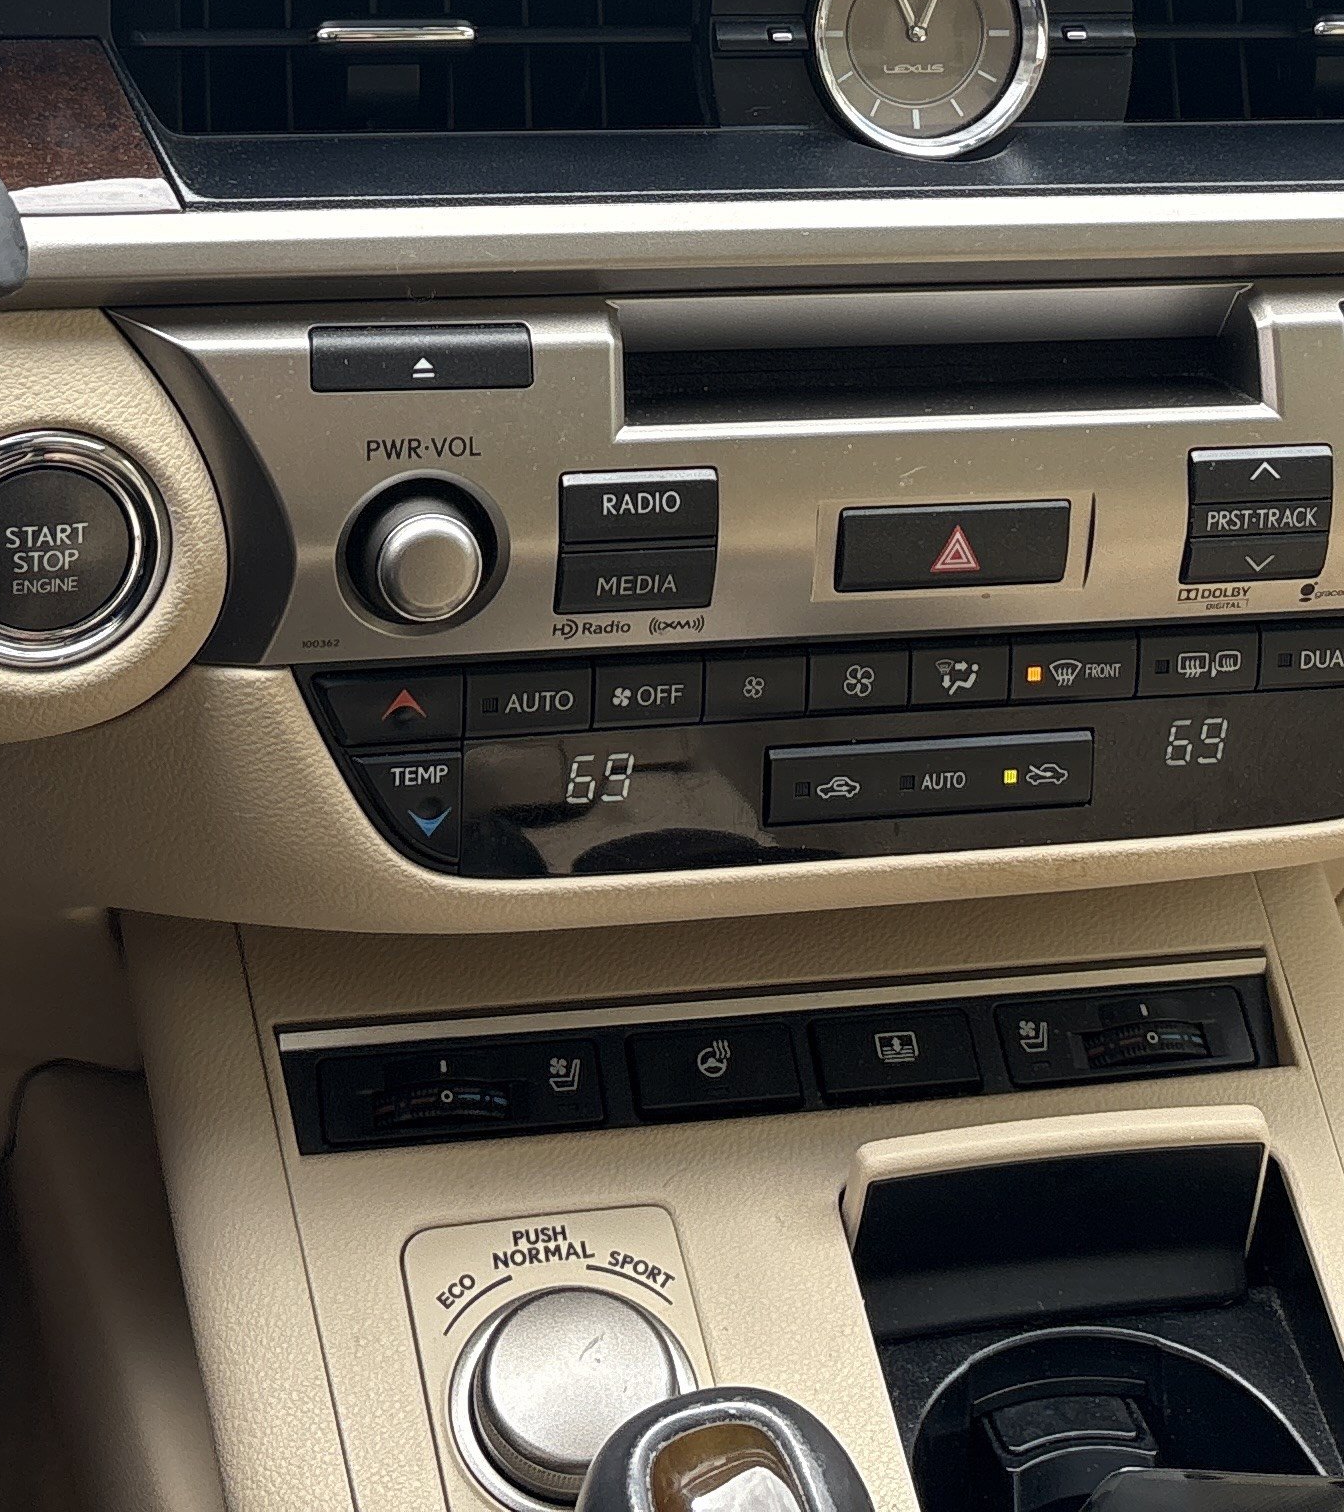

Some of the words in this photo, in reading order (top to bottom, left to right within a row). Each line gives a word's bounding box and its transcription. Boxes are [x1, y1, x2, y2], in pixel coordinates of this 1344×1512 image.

[884, 63, 945, 74] LEXUS
[602, 490, 681, 516] RADIO
[5, 522, 89, 549] START
[13, 549, 79, 573] STOP
[12, 576, 79, 595] ENGINE
[596, 574, 677, 597] MEDIA
[1201, 586, 1251, 600] DOLBY
[1206, 601, 1241, 611] DIGITAL
[581, 620, 631, 636] Radio
[1085, 663, 1122, 680] FRONT
[504, 690, 574, 714] AUTO
[637, 685, 684, 706] OFF
[1165, 717, 1228, 766] 69
[391, 765, 449, 788] TEMP
[565, 751, 635, 805] 69
[921, 771, 966, 790] AUTO
[511, 1224, 568, 1247] PUSH
[435, 1273, 476, 1310] ECO
[492, 1240, 596, 1270] NORMAL
[607, 1250, 676, 1290] SPORT
